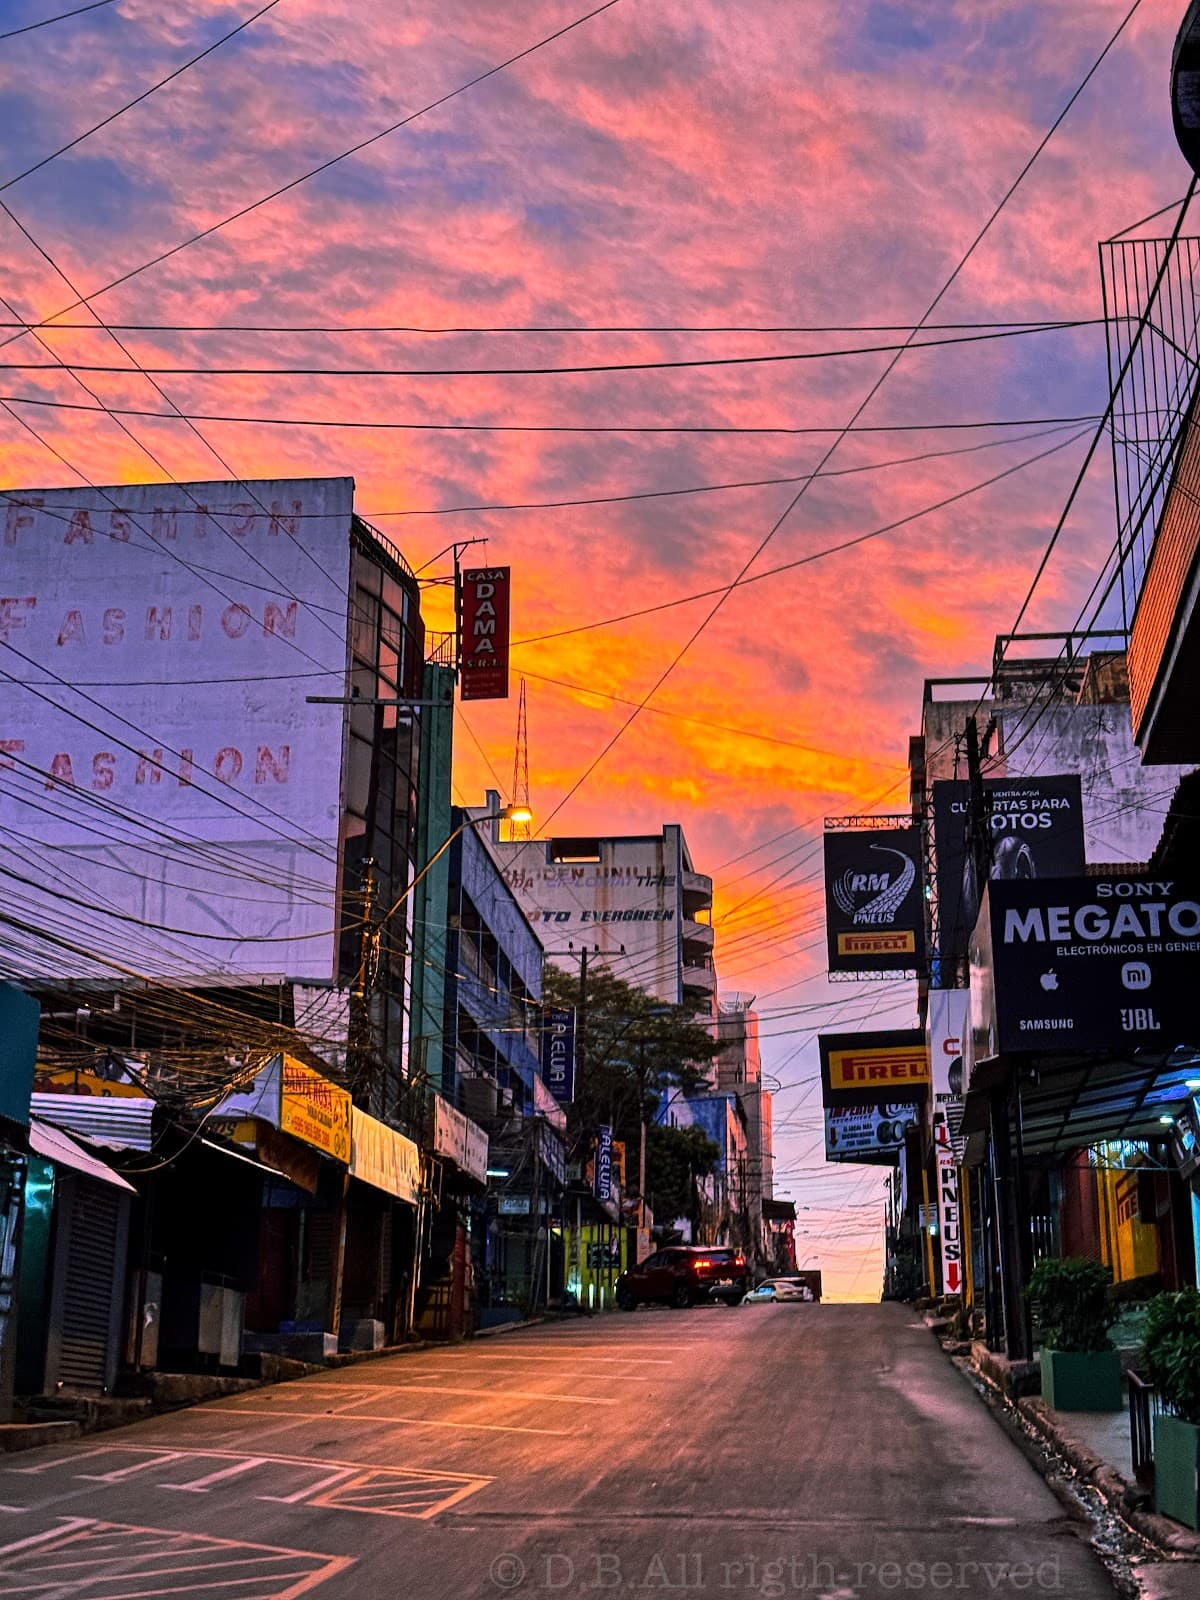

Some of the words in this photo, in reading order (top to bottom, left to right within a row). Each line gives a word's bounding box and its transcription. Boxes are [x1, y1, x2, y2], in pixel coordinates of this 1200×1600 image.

[4, 498, 303, 545] FASHION
[466, 571, 504, 580] CASA
[0, 597, 298, 647] FASHION
[473, 584, 496, 653] DAMA
[951, 799, 1028, 814] CURTAS
[1031, 798, 1070, 810] PARA
[986, 812, 1052, 829] OTOS
[852, 872, 890, 892] RM
[1096, 882, 1174, 897] SONY
[581, 909, 675, 922] EVERGREEN
[853, 911, 895, 925] PNEUS
[1004, 900, 1200, 944] MEGATO
[845, 934, 908, 951] PIRELLI
[1056, 943, 1143, 956] ELECTRÓNICOS
[1147, 943, 1162, 952] EN
[1020, 1019, 1074, 1031] SAMSUNG
[941, 1168, 960, 1260] PNEUS
